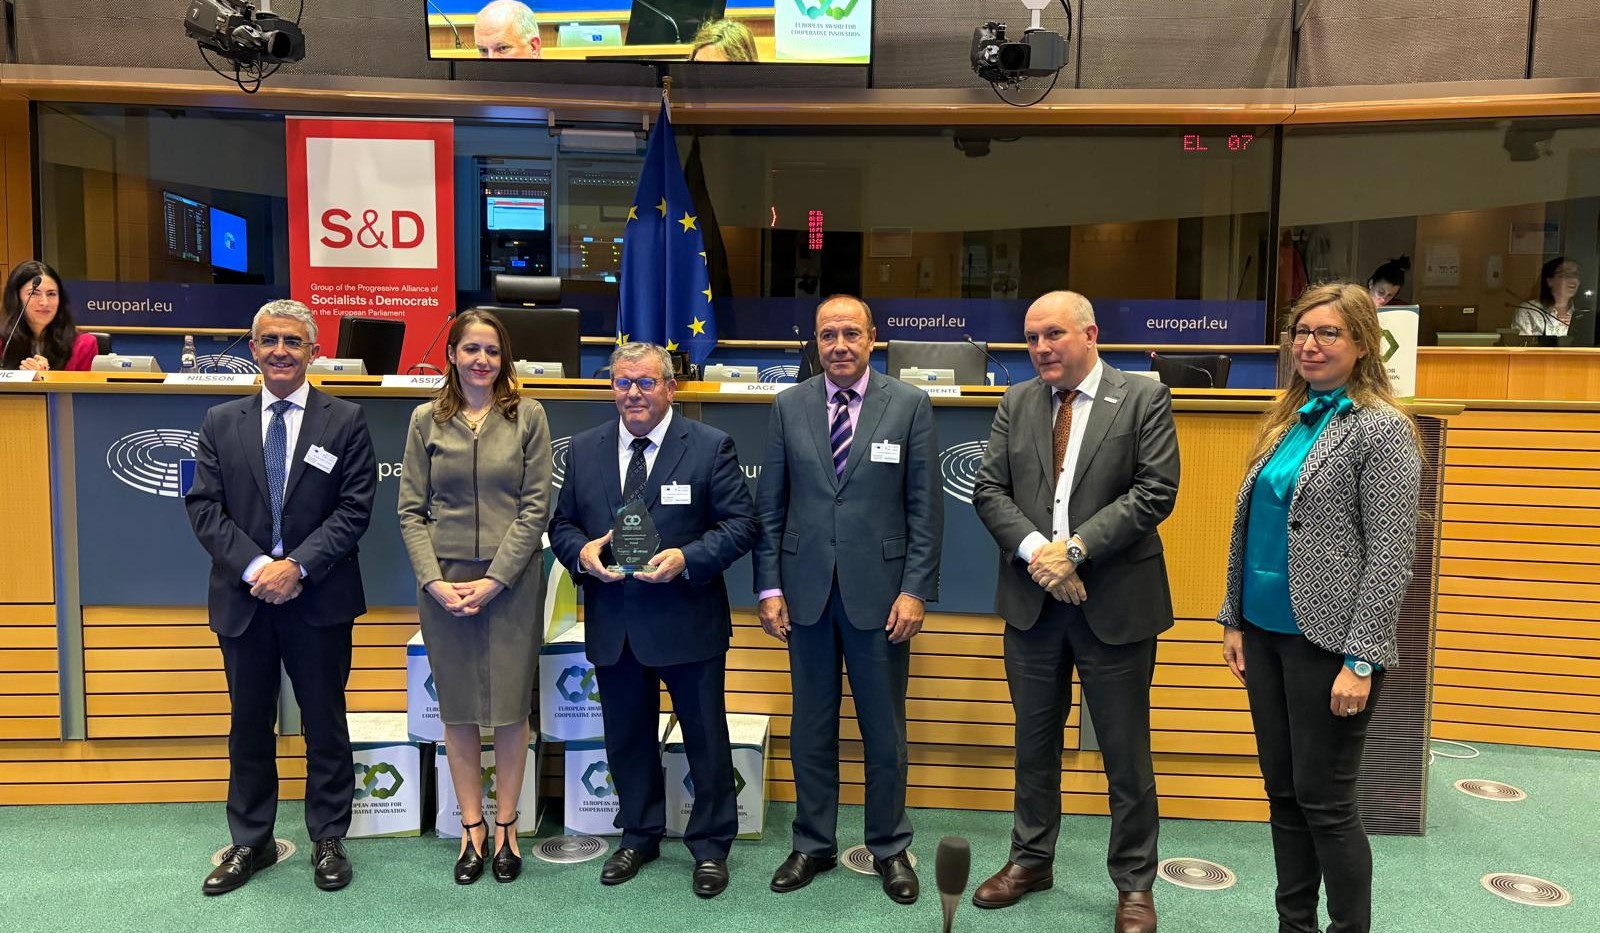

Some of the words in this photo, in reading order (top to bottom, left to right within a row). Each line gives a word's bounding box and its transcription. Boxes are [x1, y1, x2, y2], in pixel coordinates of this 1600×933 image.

[1183, 134, 1209, 150] EL
[1228, 134, 1253, 151] 07
[319, 208, 425, 249] S&D
[310, 283, 334, 293] Group
[335, 283, 343, 291] of
[357, 284, 400, 293] Progressive
[401, 284, 430, 292] Alliance
[87, 297, 173, 314] europarl.eu
[311, 294, 367, 305] Socialists
[375, 295, 439, 307] Democrats
[319, 308, 332, 316] the
[332, 309, 367, 317] European
[367, 309, 406, 317] Parliament
[887, 313, 966, 330] europarl.eu
[1146, 315, 1228, 332] europarl.eu
